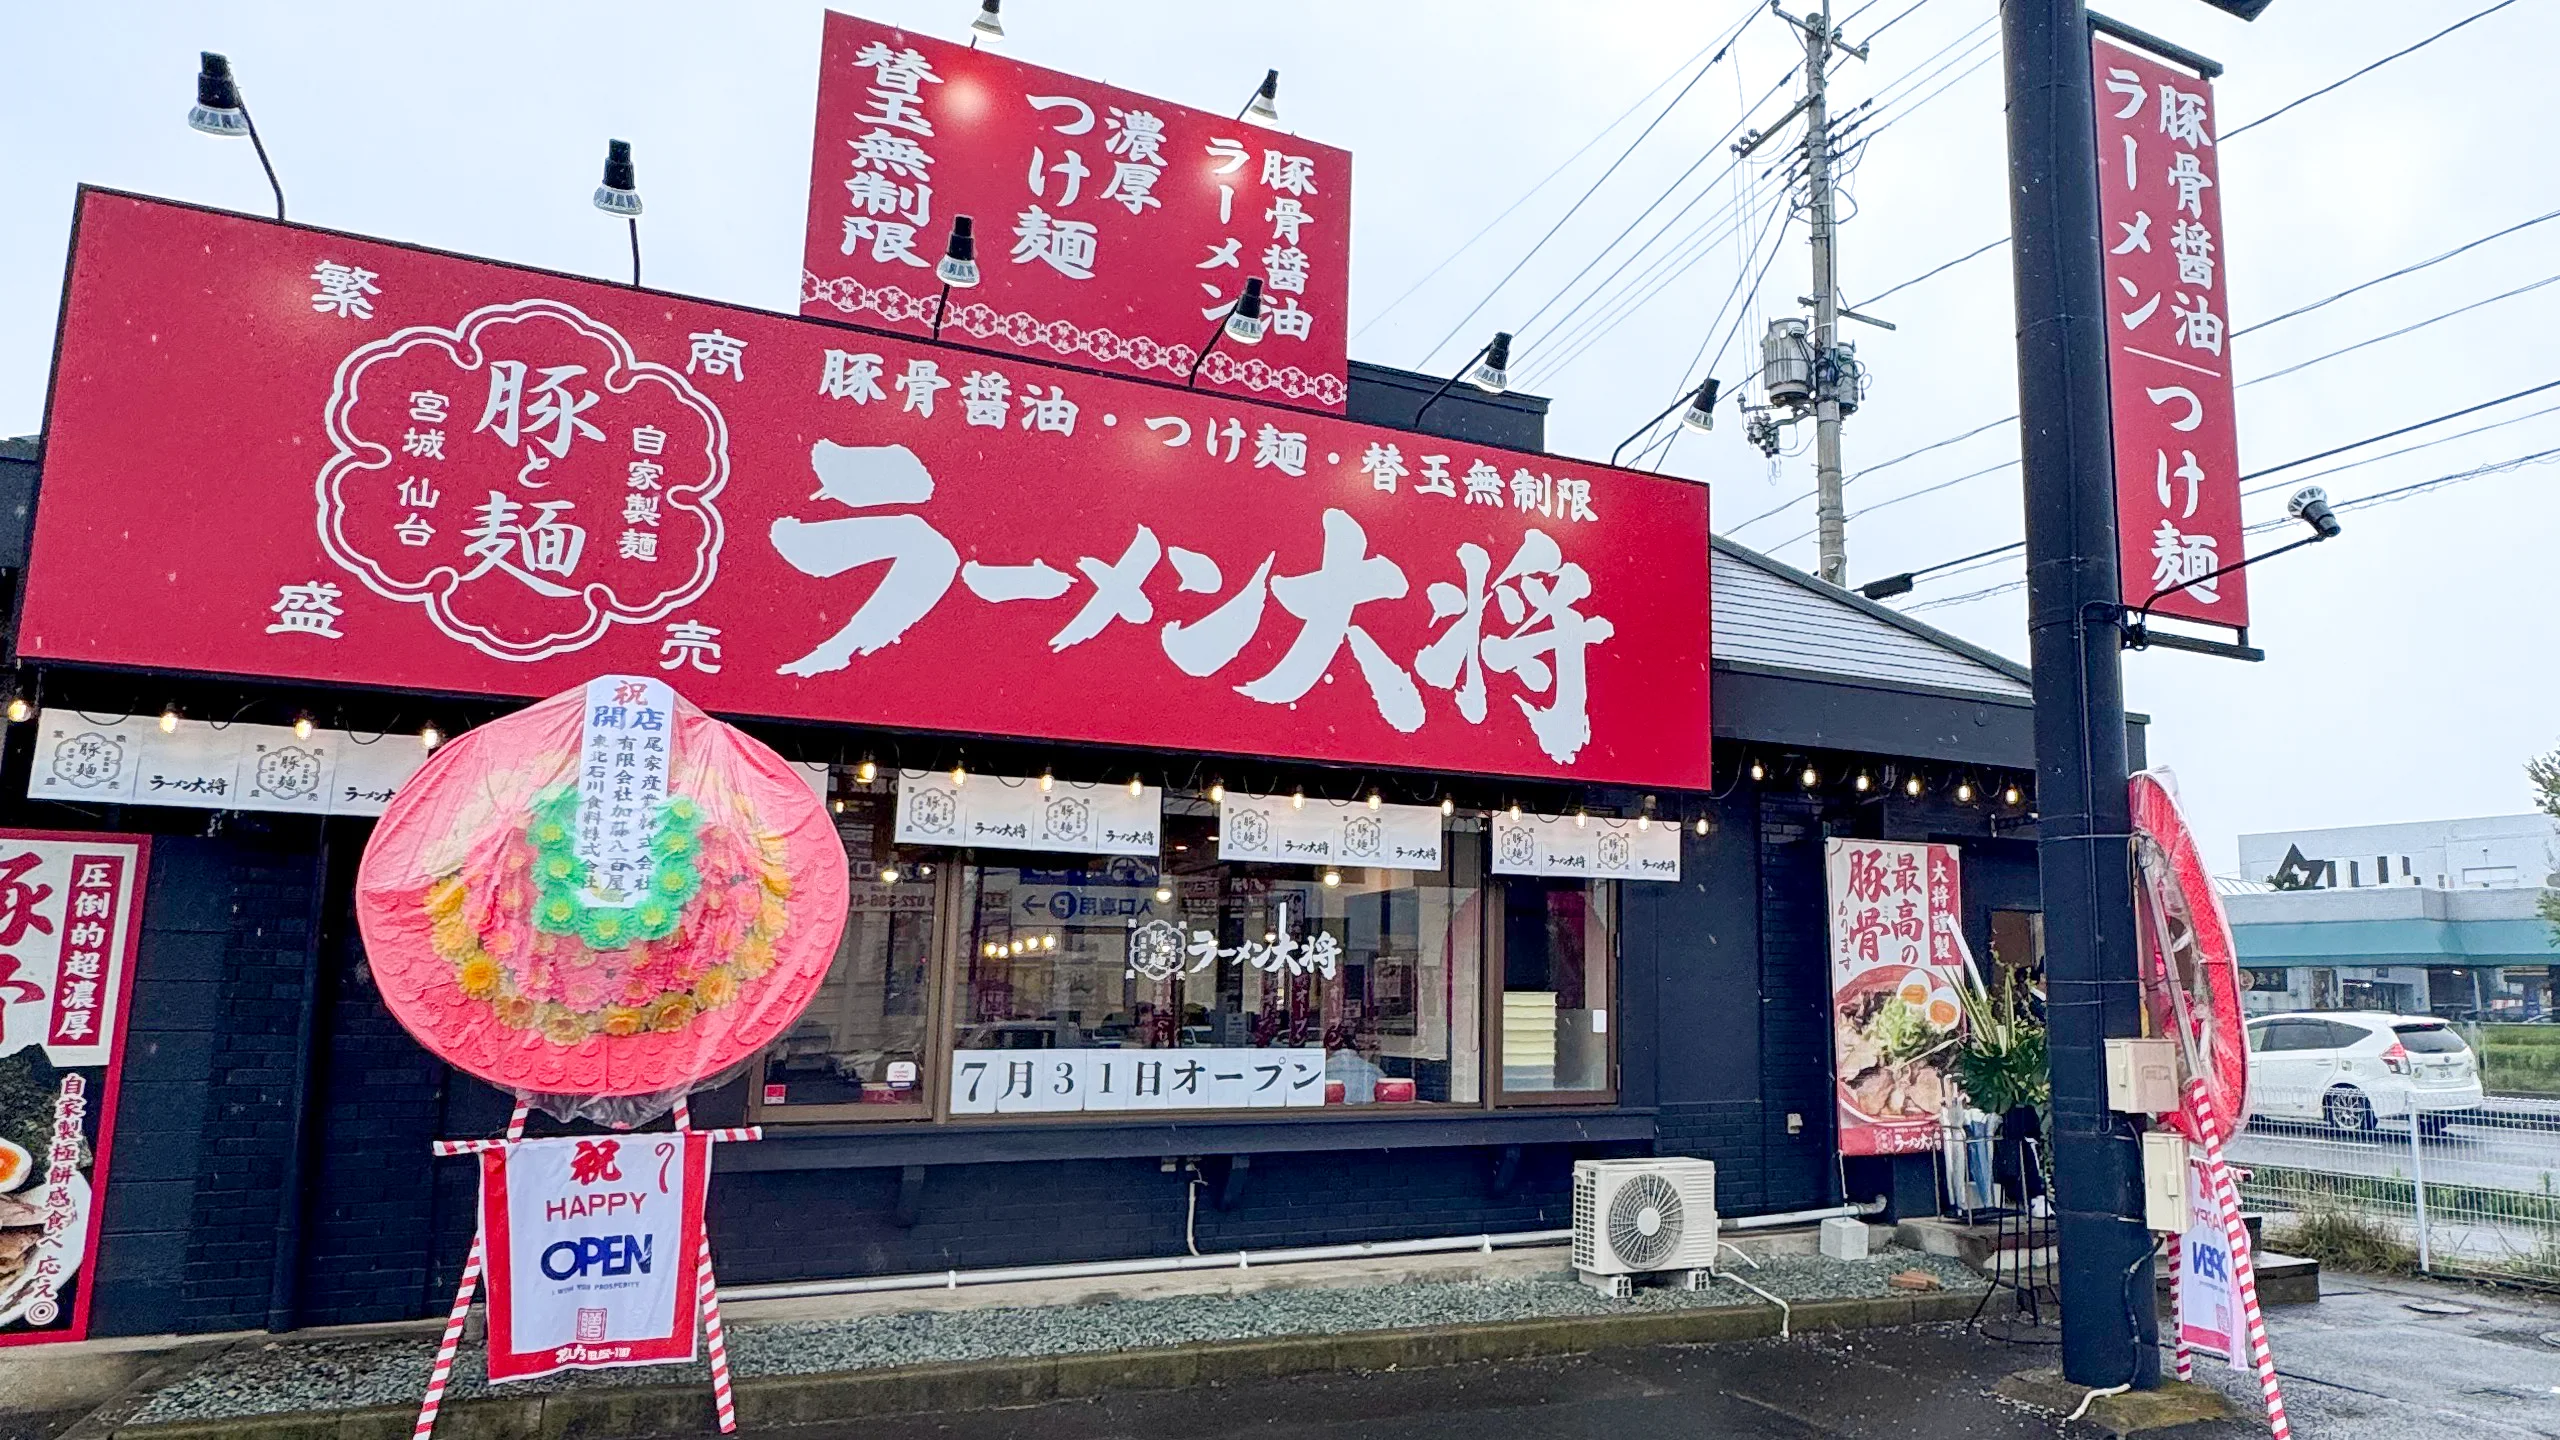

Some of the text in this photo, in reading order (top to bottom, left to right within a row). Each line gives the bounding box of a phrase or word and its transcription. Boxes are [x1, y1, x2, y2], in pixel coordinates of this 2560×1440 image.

[841, 41, 943, 269] 替玉無制限
[1012, 93, 1099, 279] つけ麺
[1101, 105, 1168, 215] 濃厚
[2105, 66, 2161, 331] ラーメン
[1196, 137, 1250, 322] ラーメン
[1260, 149, 1318, 342] 豚骨醤油
[2159, 84, 2224, 357] 豚骨醤油
[311, 260, 381, 320] 繁
[686, 329, 749, 382] 商
[393, 390, 449, 548] 宮城 仙台
[460, 360, 606, 597] 豚と麺
[618, 424, 667, 563] 自家製麺
[2145, 386, 2221, 605] つけ麺
[265, 580, 344, 639] 盛
[660, 619, 722, 675] 売
[769, 438, 1615, 766] ラーメン大将
[592, 705, 665, 731] 開店
[612, 680, 648, 706] 祝
[150, 775, 228, 796] ラーメン大将
[344, 787, 397, 803] ラーメン大
[975, 822, 1027, 838] ラーメン大将
[1106, 830, 1154, 845] ラーメン大将
[55, 863, 112, 1041] 圧倒的超濃厚
[1187, 930, 1342, 981] ラーメン大将
[1846, 848, 1891, 962] 豚骨
[1891, 853, 1924, 965] 最高の
[546, 1192, 647, 1222] HAPPY
[571, 1139, 622, 1186] 祝
[540, 1234, 653, 1280] OPEN
